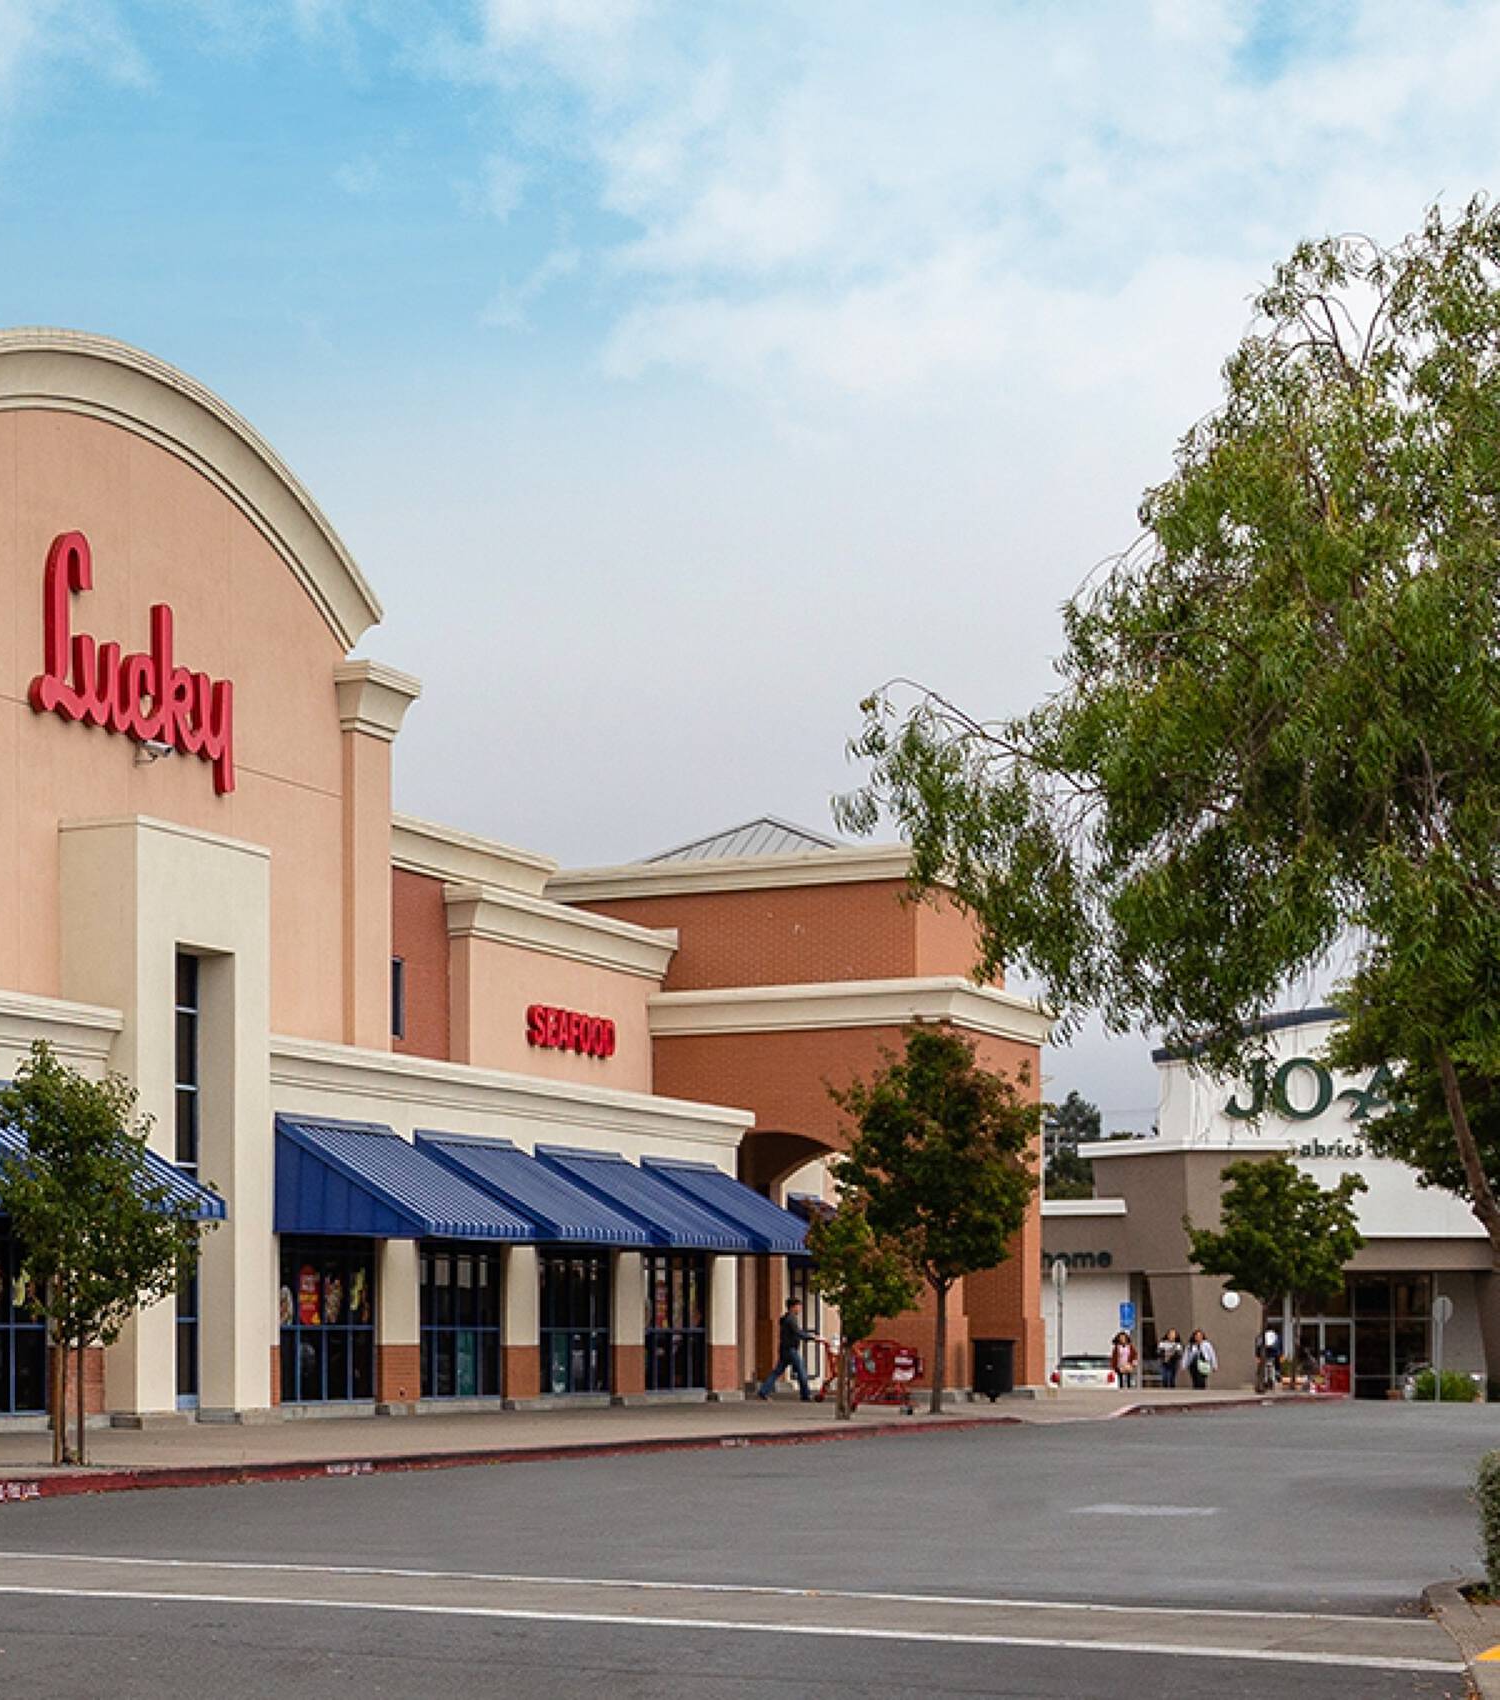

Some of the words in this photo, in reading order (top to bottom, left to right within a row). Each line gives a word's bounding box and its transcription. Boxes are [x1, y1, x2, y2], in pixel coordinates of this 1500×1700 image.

[29, 530, 236, 796] Lucky
[526, 1004, 616, 1060] SEAFOOD
[1291, 1136, 1364, 1159] abrics
